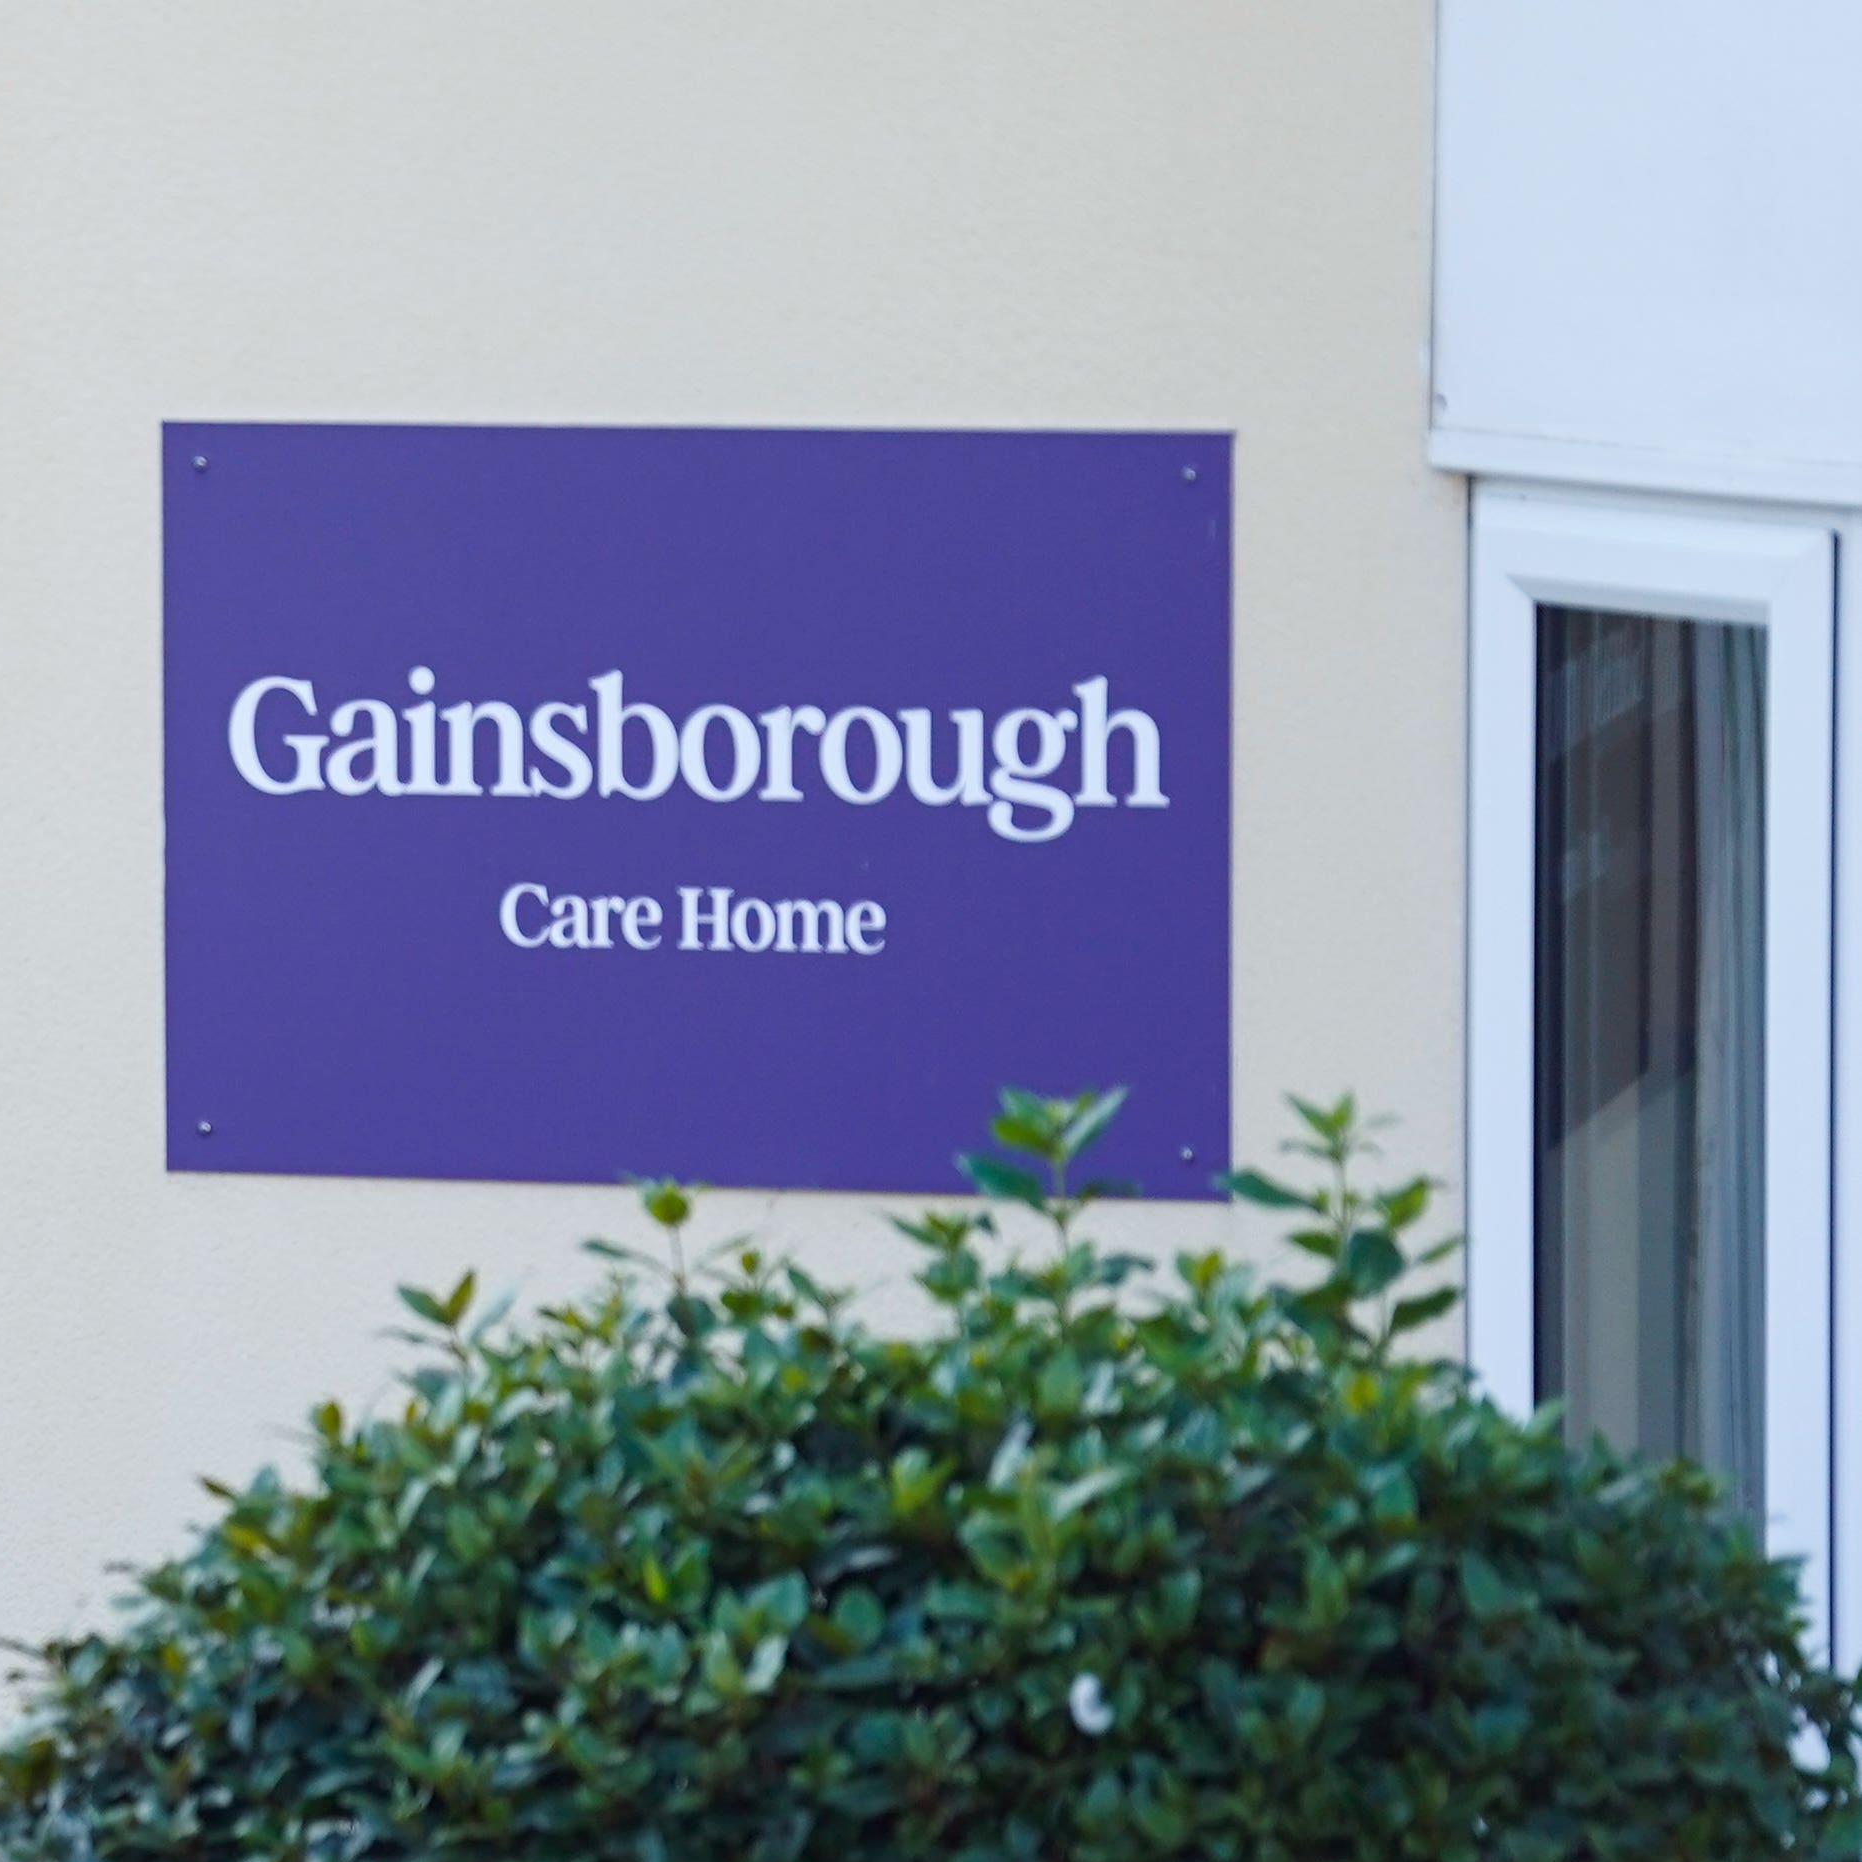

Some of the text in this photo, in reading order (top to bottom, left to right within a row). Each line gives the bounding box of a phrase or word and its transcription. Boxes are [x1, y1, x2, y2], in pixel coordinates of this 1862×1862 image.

[227, 665, 1169, 843] Gainsborough
[498, 881, 887, 955] Care Home
